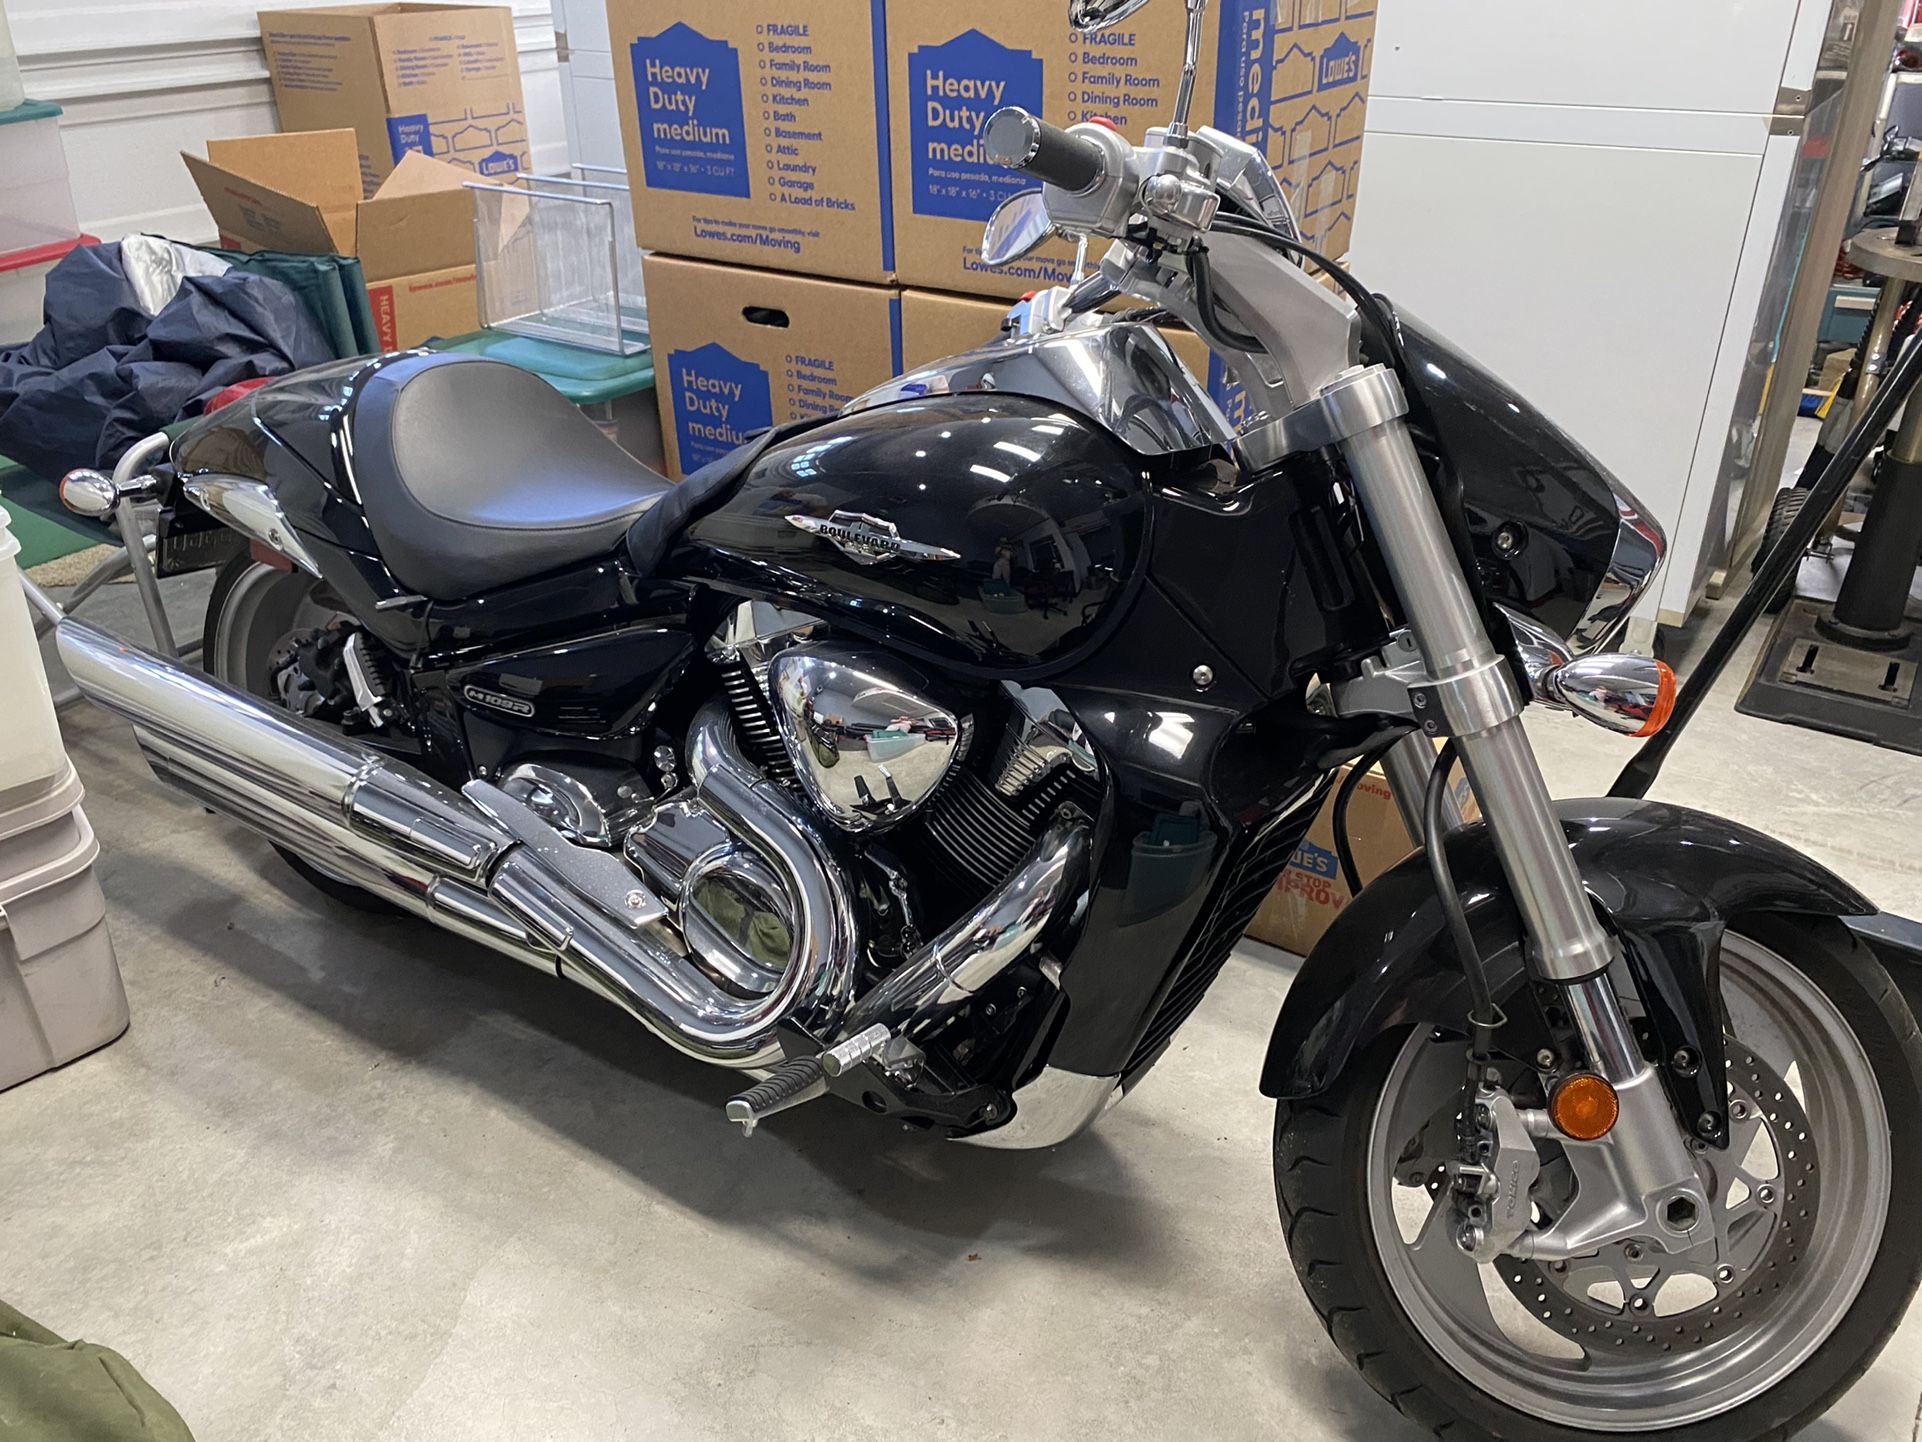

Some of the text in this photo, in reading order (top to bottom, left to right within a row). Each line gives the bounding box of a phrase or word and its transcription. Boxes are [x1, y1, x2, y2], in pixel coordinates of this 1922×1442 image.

[767, 24, 809, 37] FRAGILE
[1082, 32, 1136, 46] FRAGILE
[768, 41, 812, 55] Bedroom
[769, 59, 832, 74] Family Room
[1082, 51, 1138, 67] Bedroom
[645, 58, 710, 90] Heavy
[1321, 51, 1356, 85] LOWE'S
[771, 76, 832, 92] Dining Room
[1081, 71, 1160, 88] Family Room
[1244, 8, 1265, 147] medi
[926, 69, 1006, 106] Heavy
[649, 86, 696, 117] Duty
[772, 93, 809, 107] Kitchen
[1081, 91, 1158, 109] Dining Room
[773, 110, 797, 123] Bath
[927, 101, 985, 136] Duty
[652, 119, 730, 145] medium
[774, 126, 823, 141] Basement
[776, 143, 799, 156] Attic
[482, 158, 515, 174] LOWE'S
[777, 160, 817, 176] Laundry
[778, 176, 815, 192] Garage
[780, 192, 856, 211] A Load of Bricks
[694, 226, 801, 254] Lowes.com/Moving
[380, 295, 393, 342] HEAVY
[795, 355, 835, 371] FRAGILE
[682, 367, 742, 402] Heavy
[796, 370, 838, 386] Bedroom
[797, 384, 827, 400] Family
[685, 391, 728, 421] Duty
[798, 399, 828, 414] Dining
[688, 421, 744, 445] mediu
[820, 524, 901, 551] BOULEVARD
